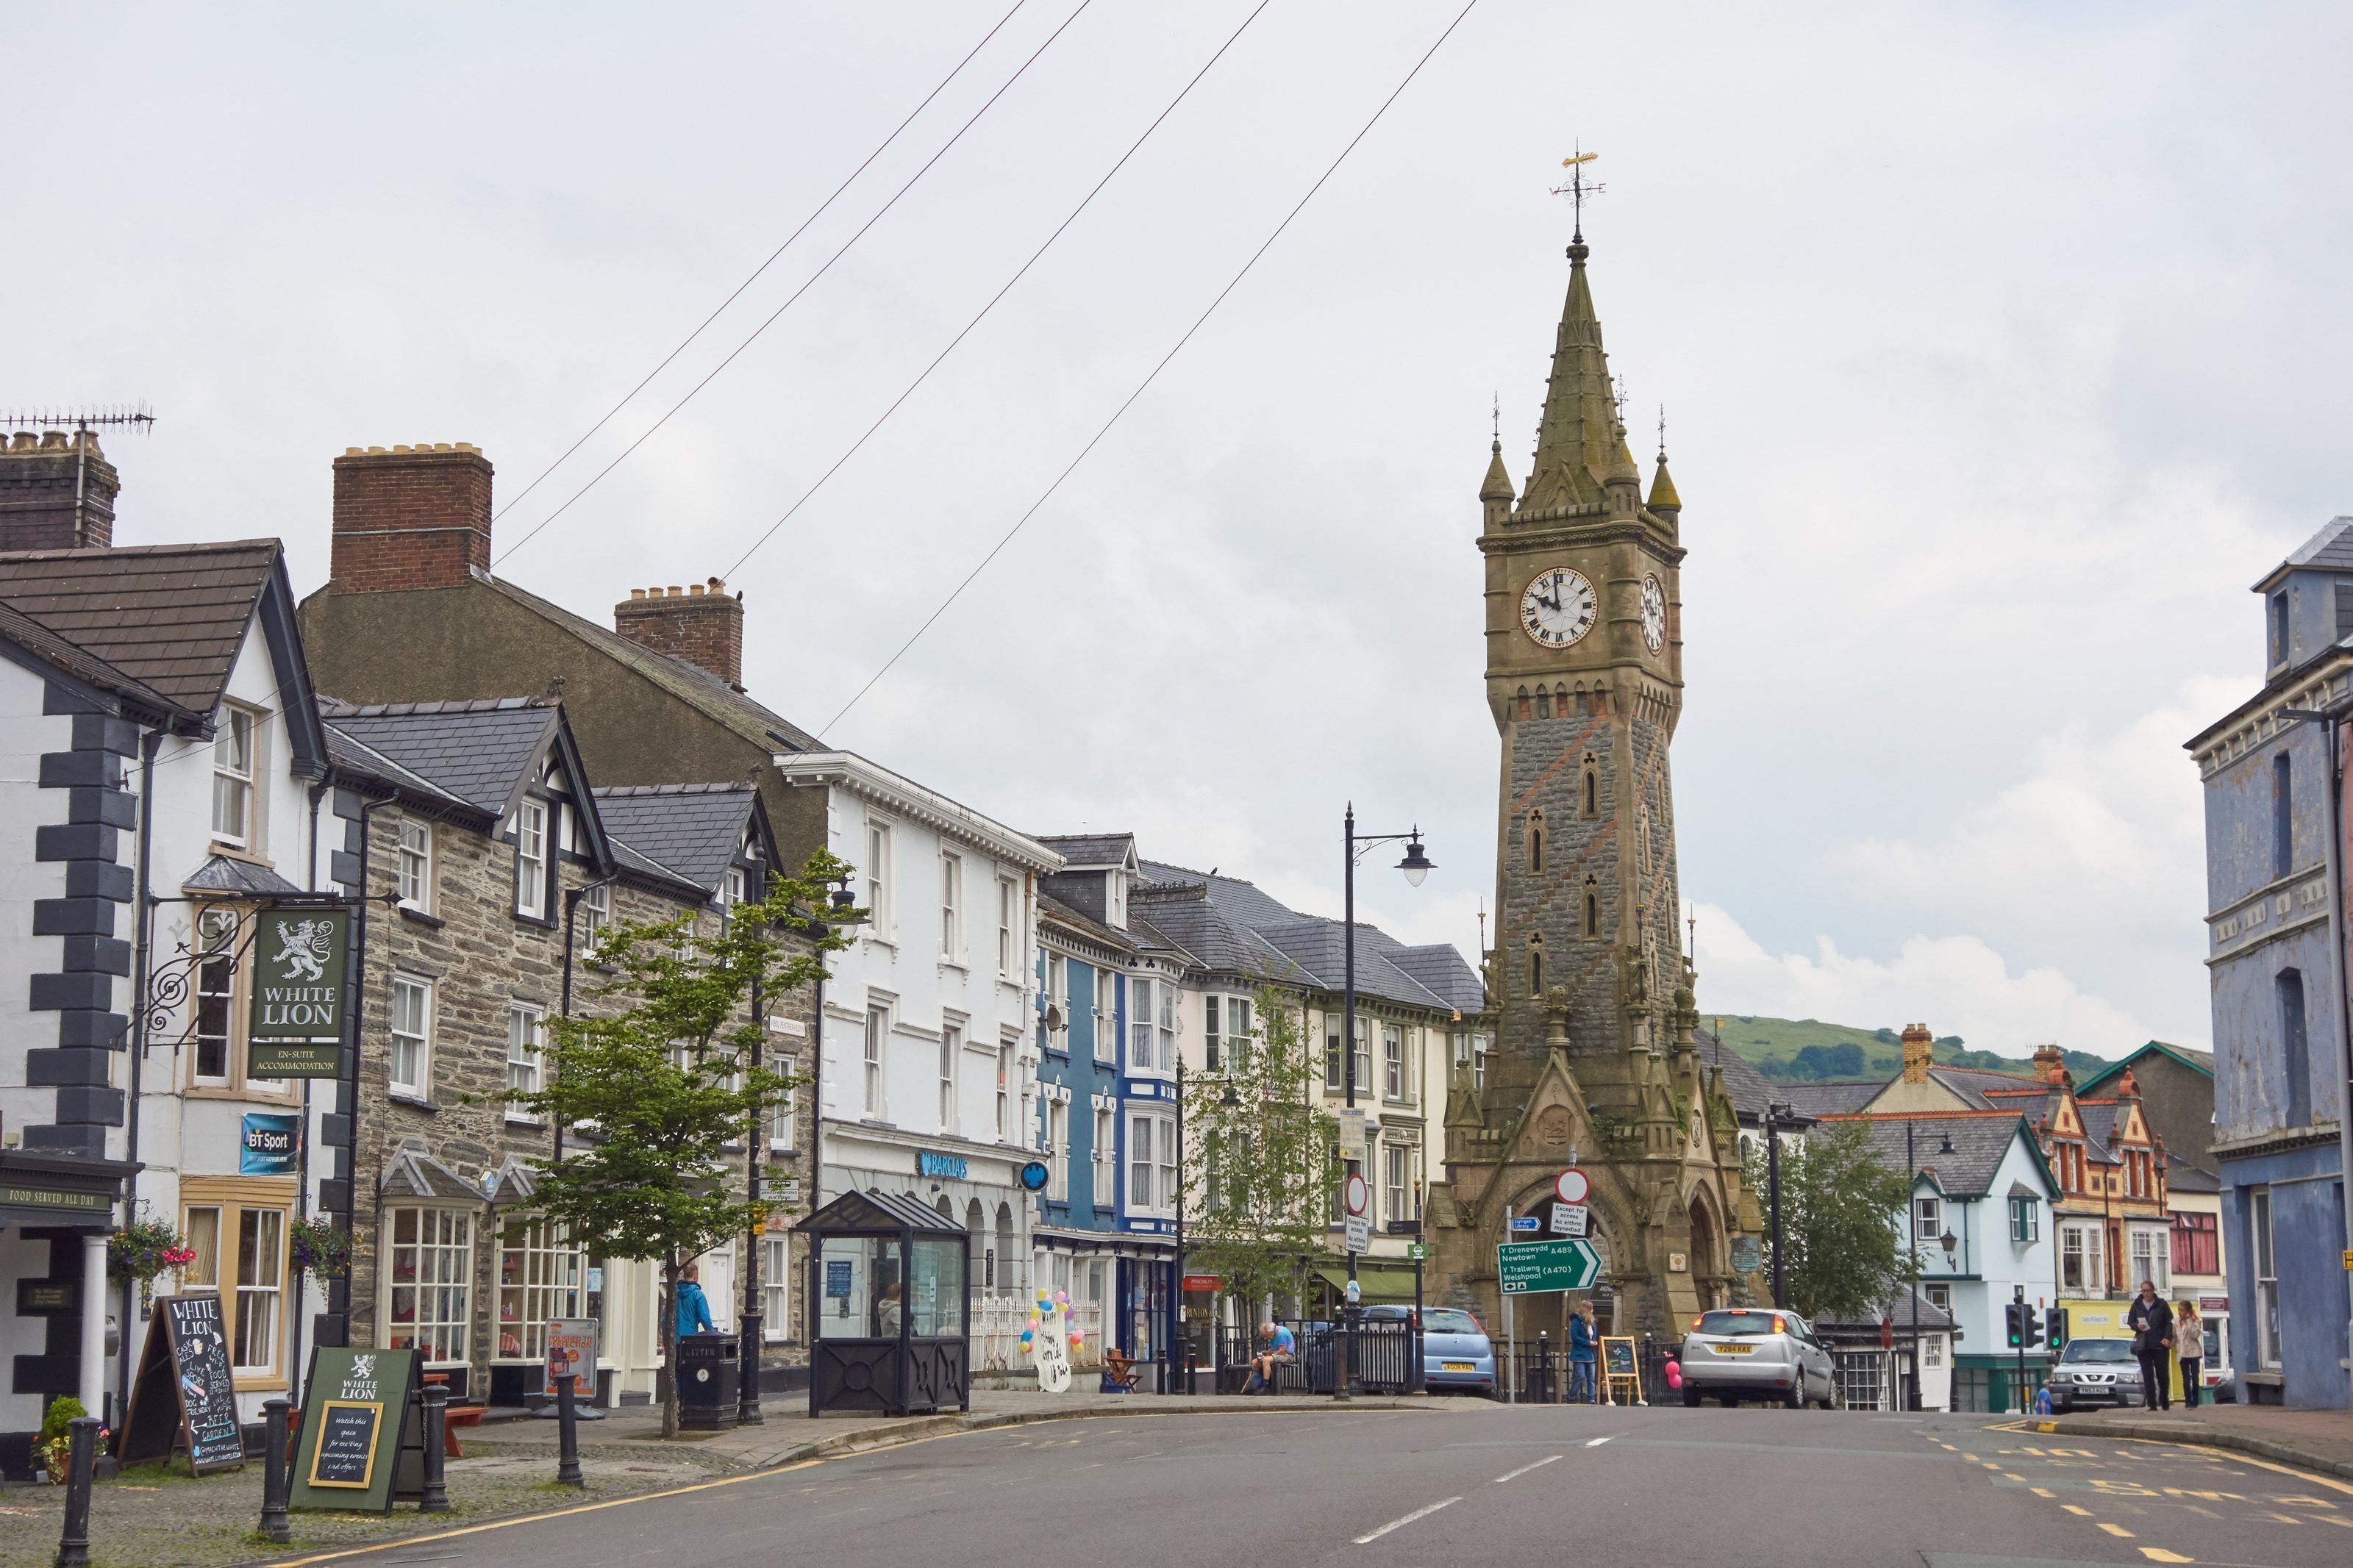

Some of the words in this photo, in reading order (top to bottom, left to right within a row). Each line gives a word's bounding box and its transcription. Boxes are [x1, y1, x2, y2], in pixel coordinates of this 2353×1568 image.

[264, 987, 335, 1001] WHITE
[261, 1004, 335, 1025] LION
[278, 1050, 315, 1059] EN-SUITE
[257, 1062, 335, 1070] ACCOMMODATION
[249, 1134, 263, 1147] BT
[265, 1133, 288, 1151] Sport
[932, 1154, 969, 1179] BARCLAYS
[10, 1190, 31, 1201] FOOD
[35, 1192, 62, 1203] SERVED
[65, 1195, 78, 1204] ALL
[81, 1195, 95, 1206] DAY
[1349, 1217, 1360, 1226] Except
[1349, 1243, 1365, 1251] mynediad
[1509, 1245, 1549, 1253] Drenewydd
[1543, 1266, 1572, 1275] (A470)
[173, 1300, 218, 1319] WHITE
[182, 1320, 212, 1335] LION
[176, 1339, 193, 1356] CASK
[207, 1344, 225, 1363] FREE
[179, 1348, 194, 1364] ALES
[190, 1361, 206, 1376] LIVE
[184, 1369, 204, 1386] SPORT
[210, 1370, 226, 1381] FOOD
[210, 1379, 229, 1389] SERVED
[343, 1381, 378, 1389] WHITE
[340, 1388, 376, 1400] LION
[213, 1395, 224, 1407] LIVE
[187, 1406, 211, 1416] FRIENDLY
[207, 1413, 229, 1427] BEER
[202, 1427, 229, 1440] GARDEN
[328, 1439, 338, 1450] for
[339, 1441, 363, 1451] exciting
[321, 1453, 349, 1461] upcoming
[340, 1463, 357, 1473] offers
